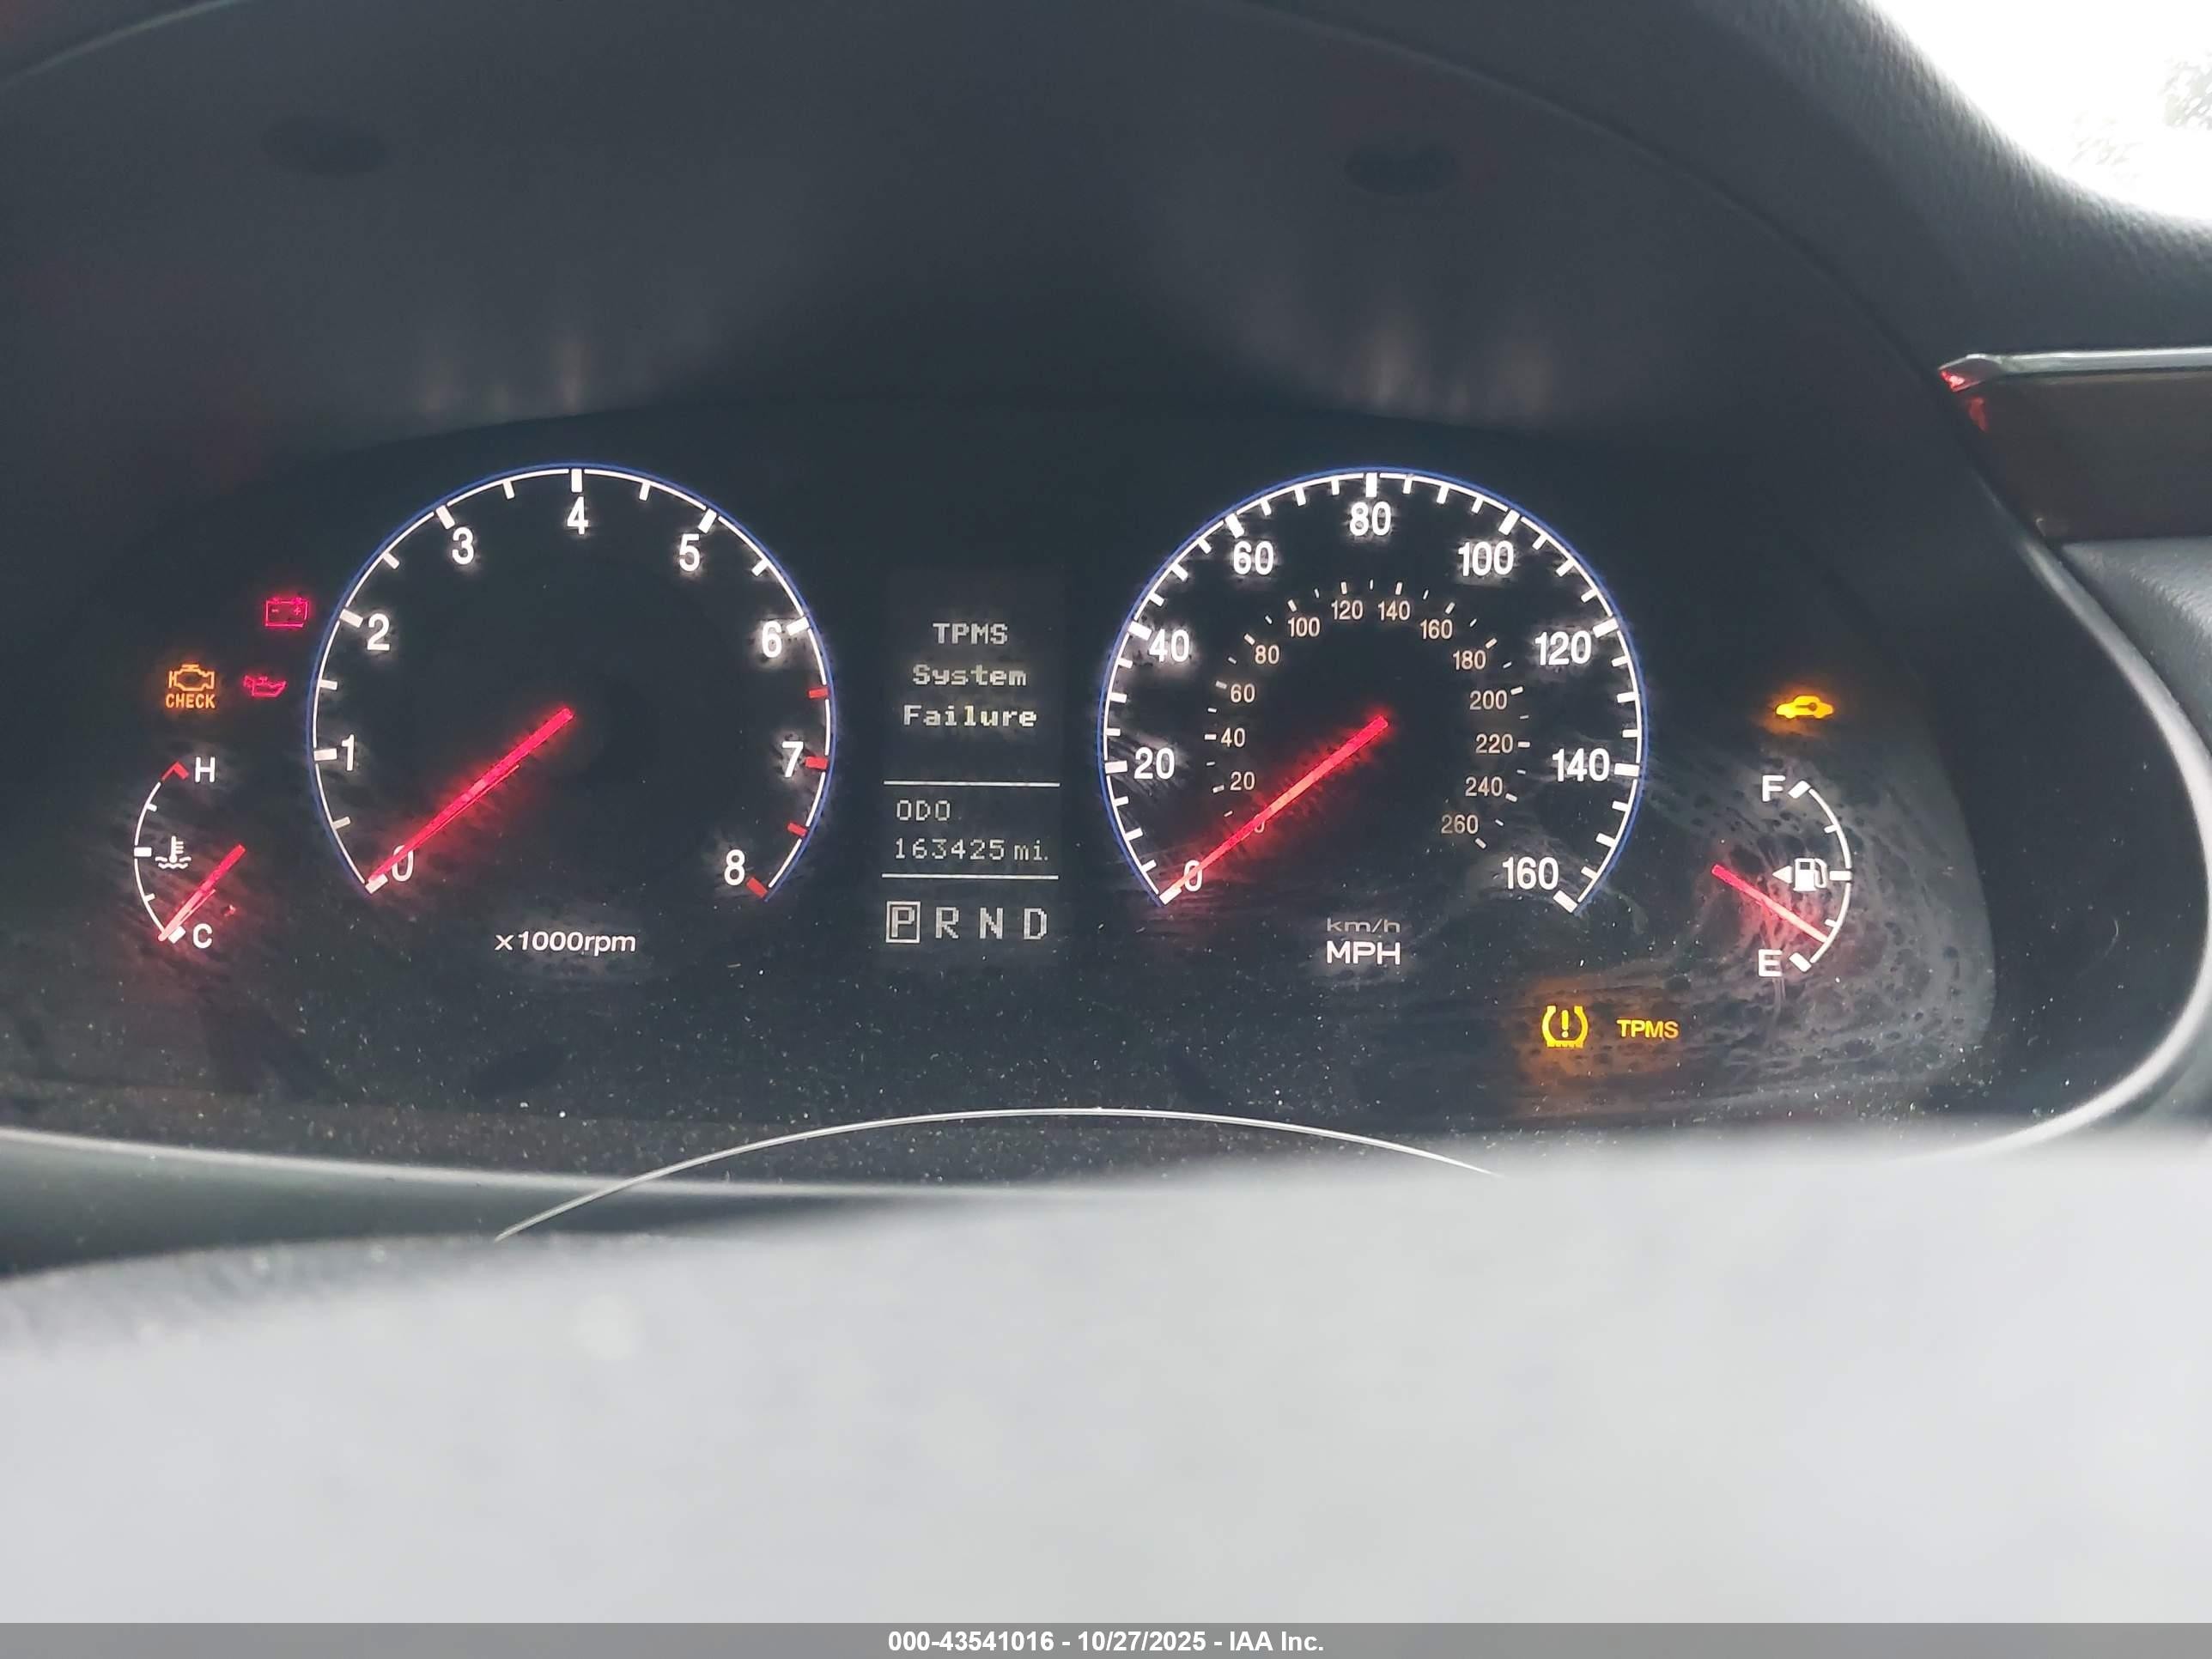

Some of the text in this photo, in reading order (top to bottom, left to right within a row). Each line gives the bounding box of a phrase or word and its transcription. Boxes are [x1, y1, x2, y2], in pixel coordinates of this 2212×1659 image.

[568, 497, 589, 535] 4
[1350, 501, 1392, 536] 80
[452, 527, 475, 564] 3
[678, 533, 701, 572] 5
[1232, 541, 1274, 575] 60
[1458, 542, 1515, 576] 100
[1331, 600, 1364, 620] 120
[1377, 600, 1411, 621] 140
[367, 613, 391, 651] 2
[761, 621, 782, 658] 6
[933, 623, 1009, 646] TPMS
[1288, 617, 1322, 637] 100
[1419, 619, 1453, 640] 160
[1149, 629, 1190, 663] 40
[1255, 645, 1280, 665] 80
[1534, 630, 1592, 665] 120
[1452, 650, 1487, 670] 180
[913, 665, 1028, 688] System
[165, 693, 216, 709] CHECK
[1230, 684, 1256, 703] 60
[1468, 690, 1508, 710] 200
[903, 704, 1037, 729] Failure
[1220, 728, 1246, 747] 40
[1475, 734, 1514, 754] 220
[341, 734, 356, 771] 1
[781, 741, 804, 778] 7
[1133, 746, 1175, 780] 20
[1551, 748, 1611, 782] 140
[194, 757, 216, 783] H
[1230, 772, 1256, 791] 20
[1464, 777, 1504, 797] 240
[1760, 774, 1786, 801] F
[896, 799, 952, 822] ODO
[1440, 815, 1480, 836] 260
[392, 845, 414, 881] 0
[895, 838, 1050, 862] 163425 mi.
[724, 849, 745, 886] 8
[1183, 860, 1204, 893] 0
[1501, 856, 1559, 890] 160
[192, 923, 213, 949] C
[891, 908, 1048, 940] P R N D
[1327, 917, 1401, 934] km/h
[1326, 941, 1401, 965] MPH
[1758, 949, 1783, 977] E
[1617, 1018, 1680, 1039] TPMS
